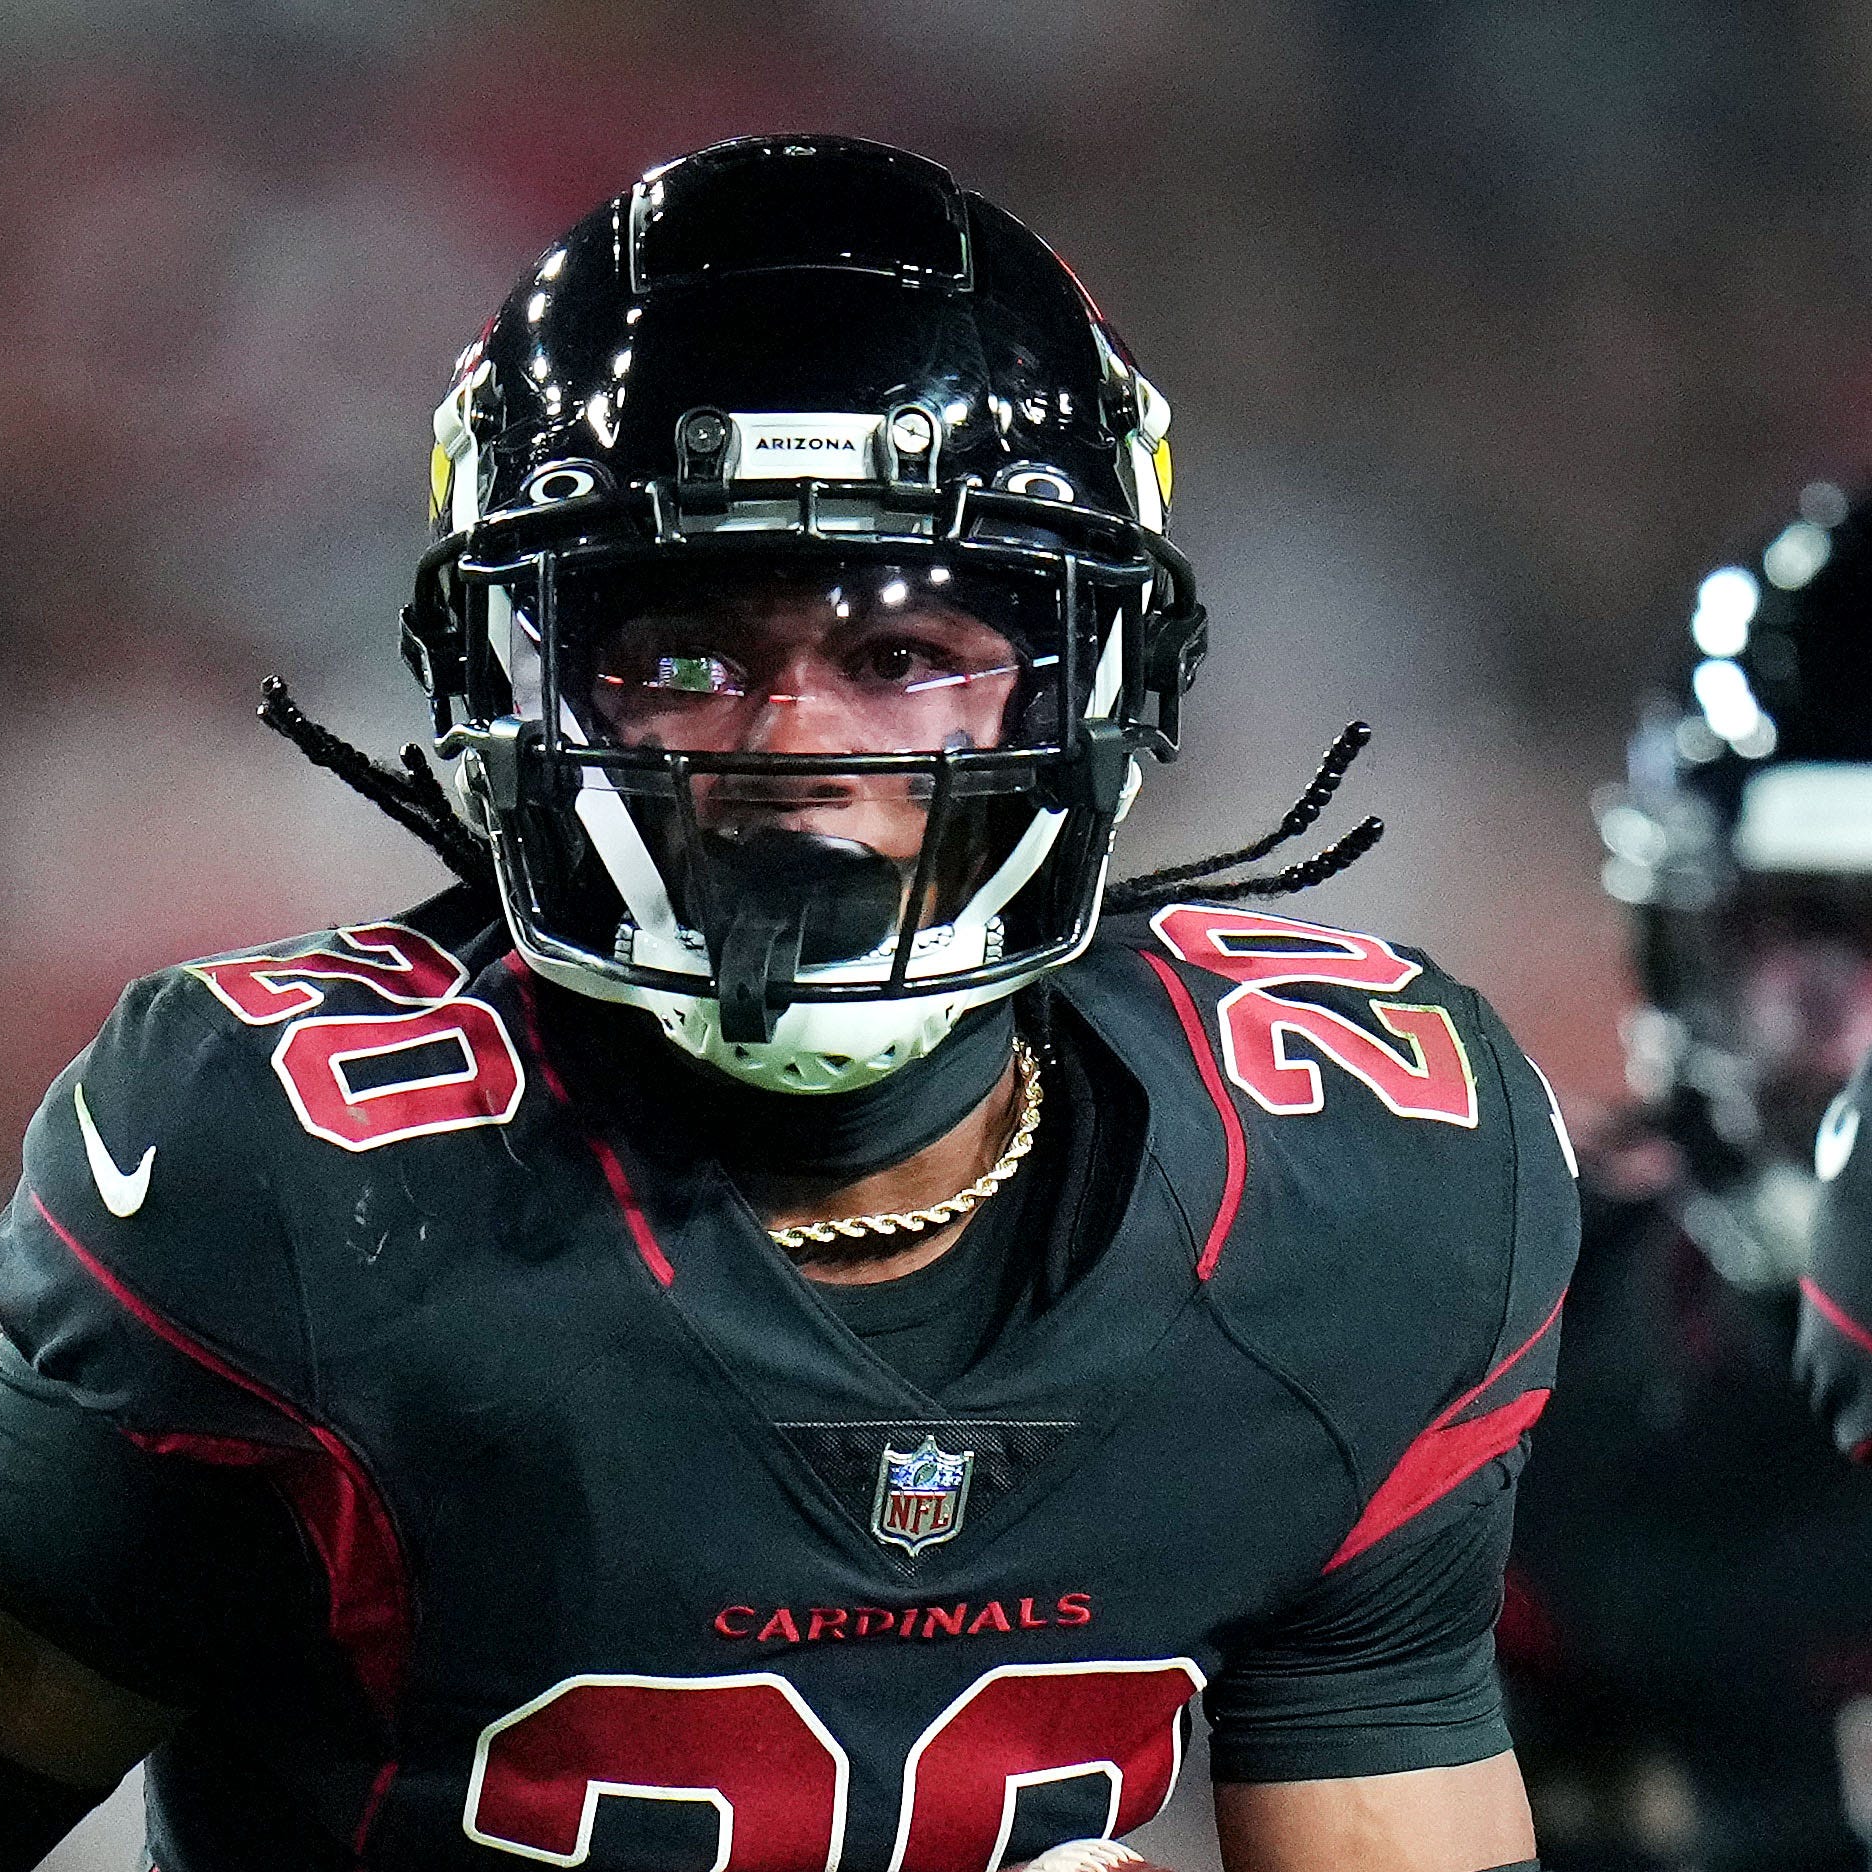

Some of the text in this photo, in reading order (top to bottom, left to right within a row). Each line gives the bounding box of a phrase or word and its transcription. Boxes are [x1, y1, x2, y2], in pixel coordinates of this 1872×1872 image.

[756, 438, 856, 451] ARIZONA
[184, 921, 526, 1152] 20
[1149, 903, 1478, 1129] 20
[886, 1493, 953, 1535] NFL
[714, 1593, 1092, 1643] CARDINALS
